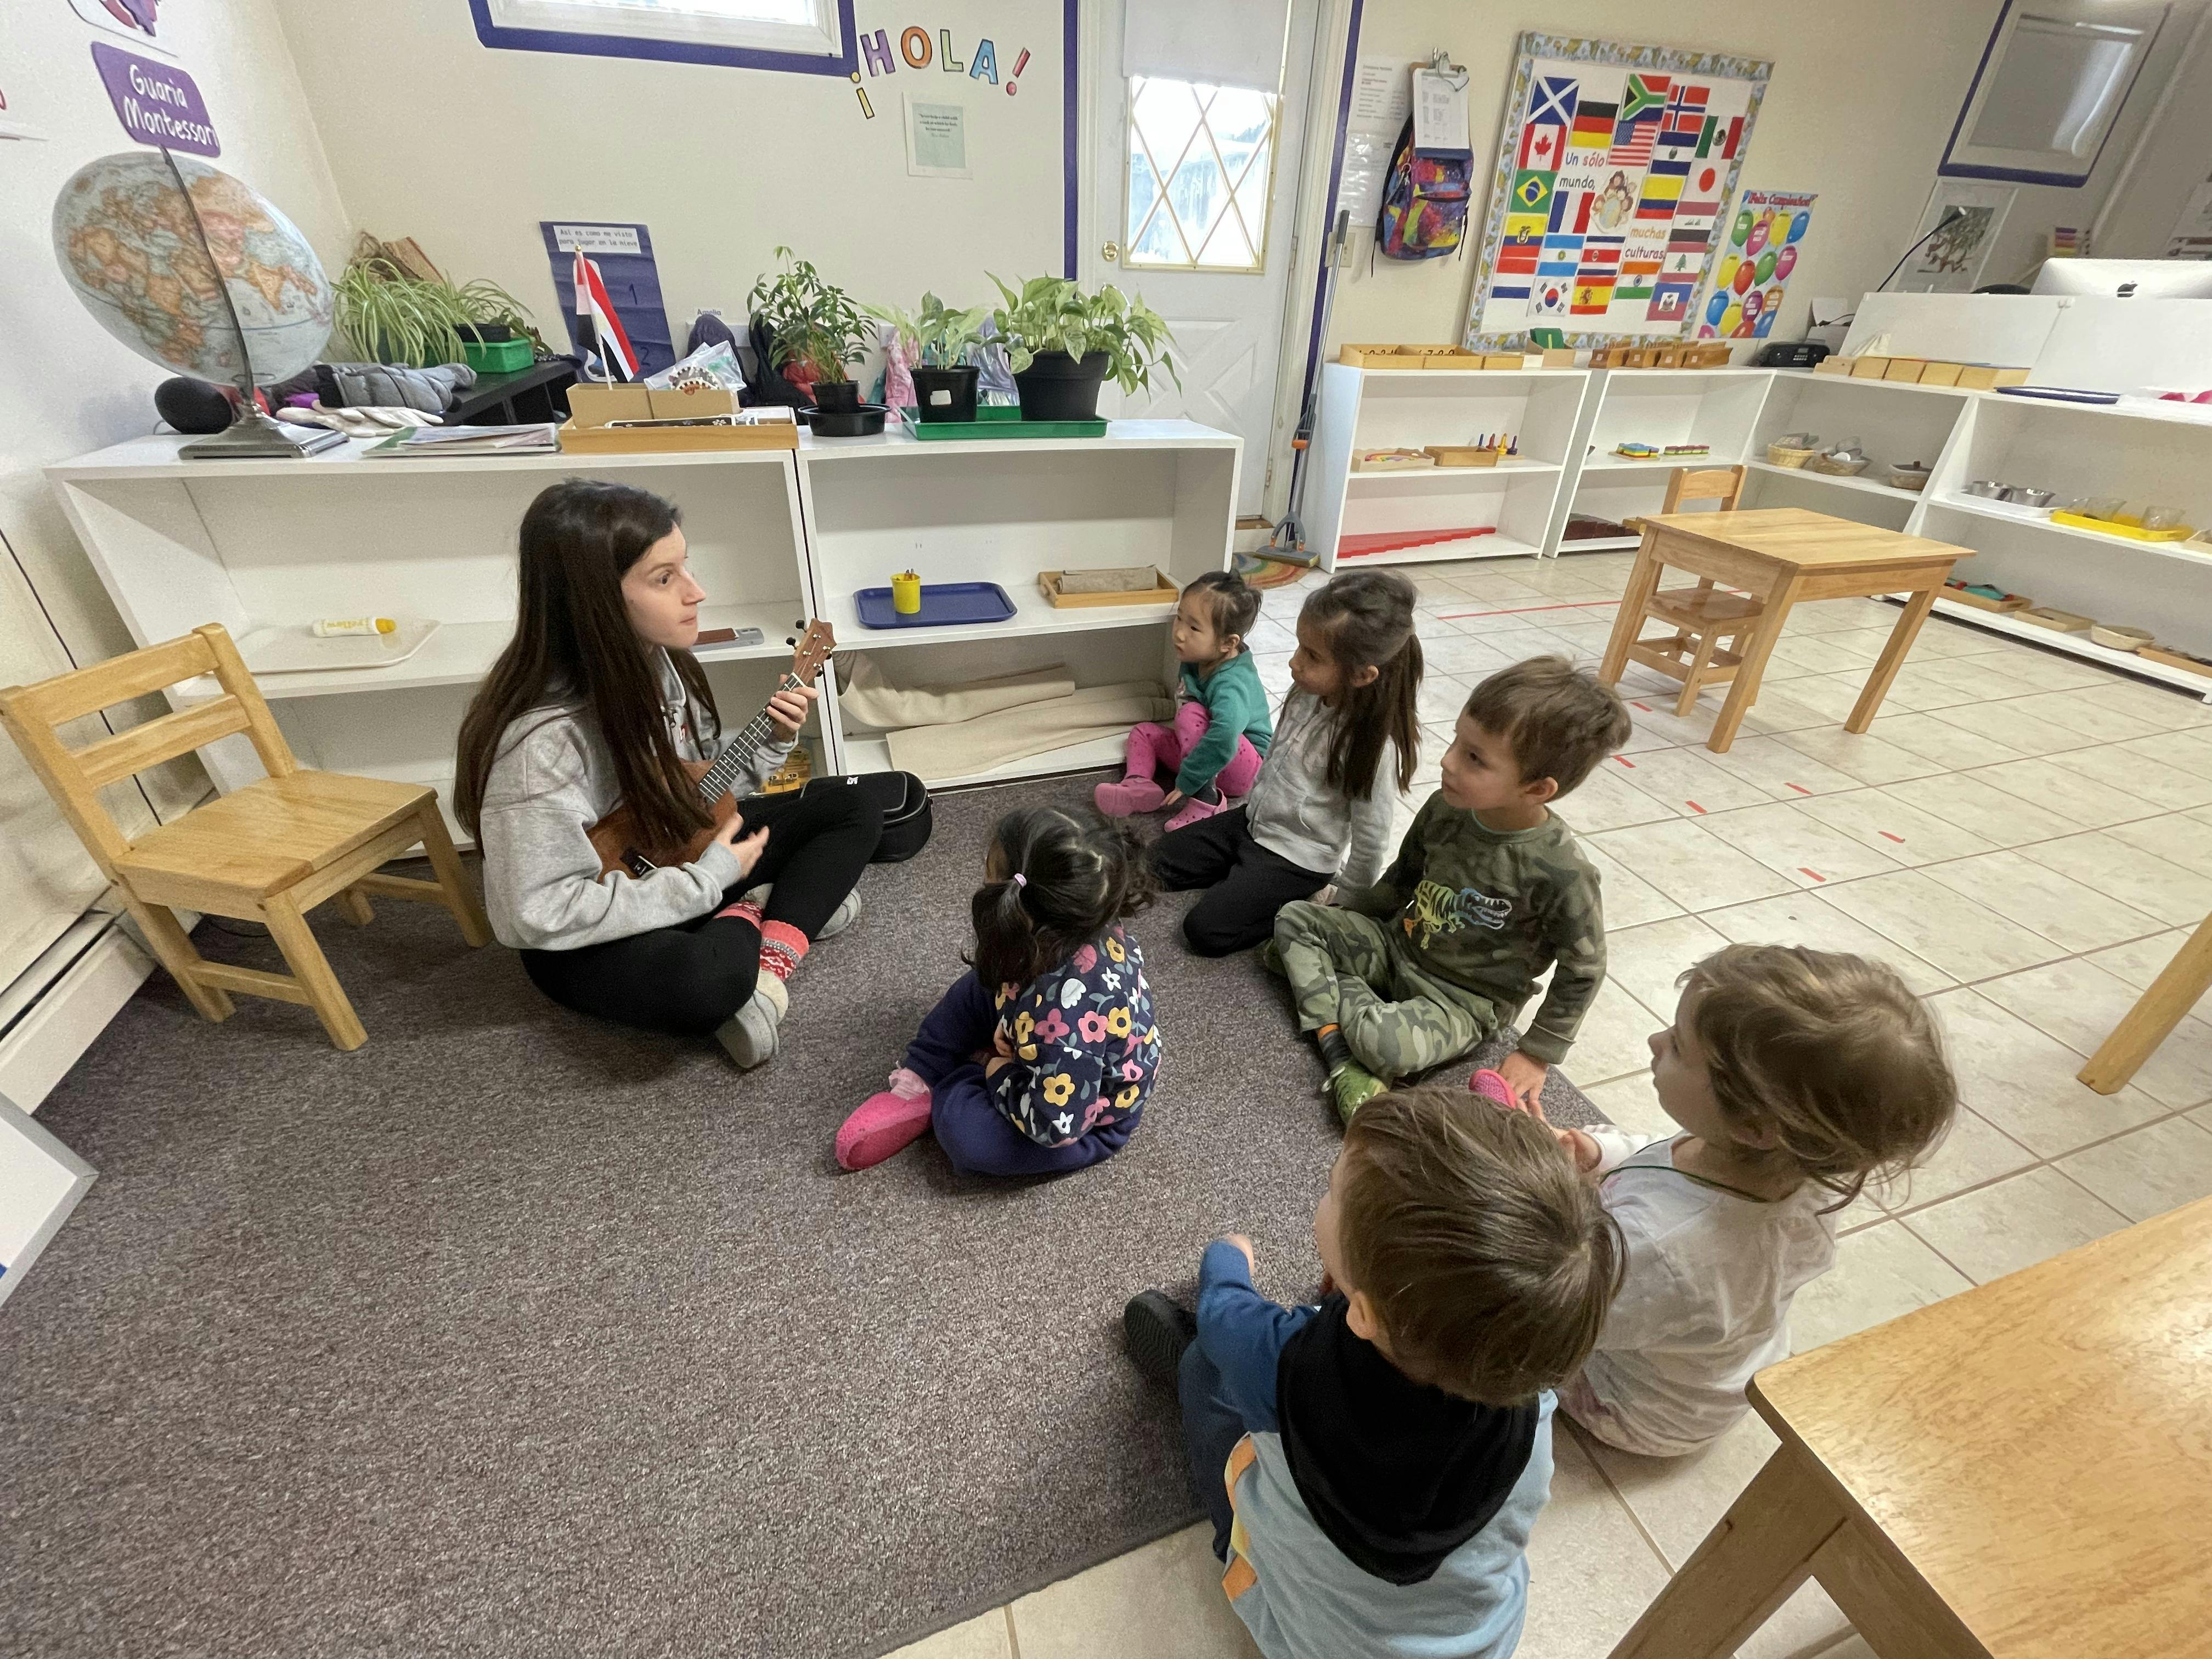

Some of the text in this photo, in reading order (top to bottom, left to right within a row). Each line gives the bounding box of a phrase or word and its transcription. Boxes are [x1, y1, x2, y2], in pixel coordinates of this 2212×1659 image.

[128, 63, 189, 110] Guaria
[123, 95, 220, 148] Montessori
[1566, 151, 1605, 167] Un sólo
[1559, 175, 1595, 191] mundo,
[1630, 226, 1666, 240] muchas
[1624, 246, 1666, 259] culturas.
